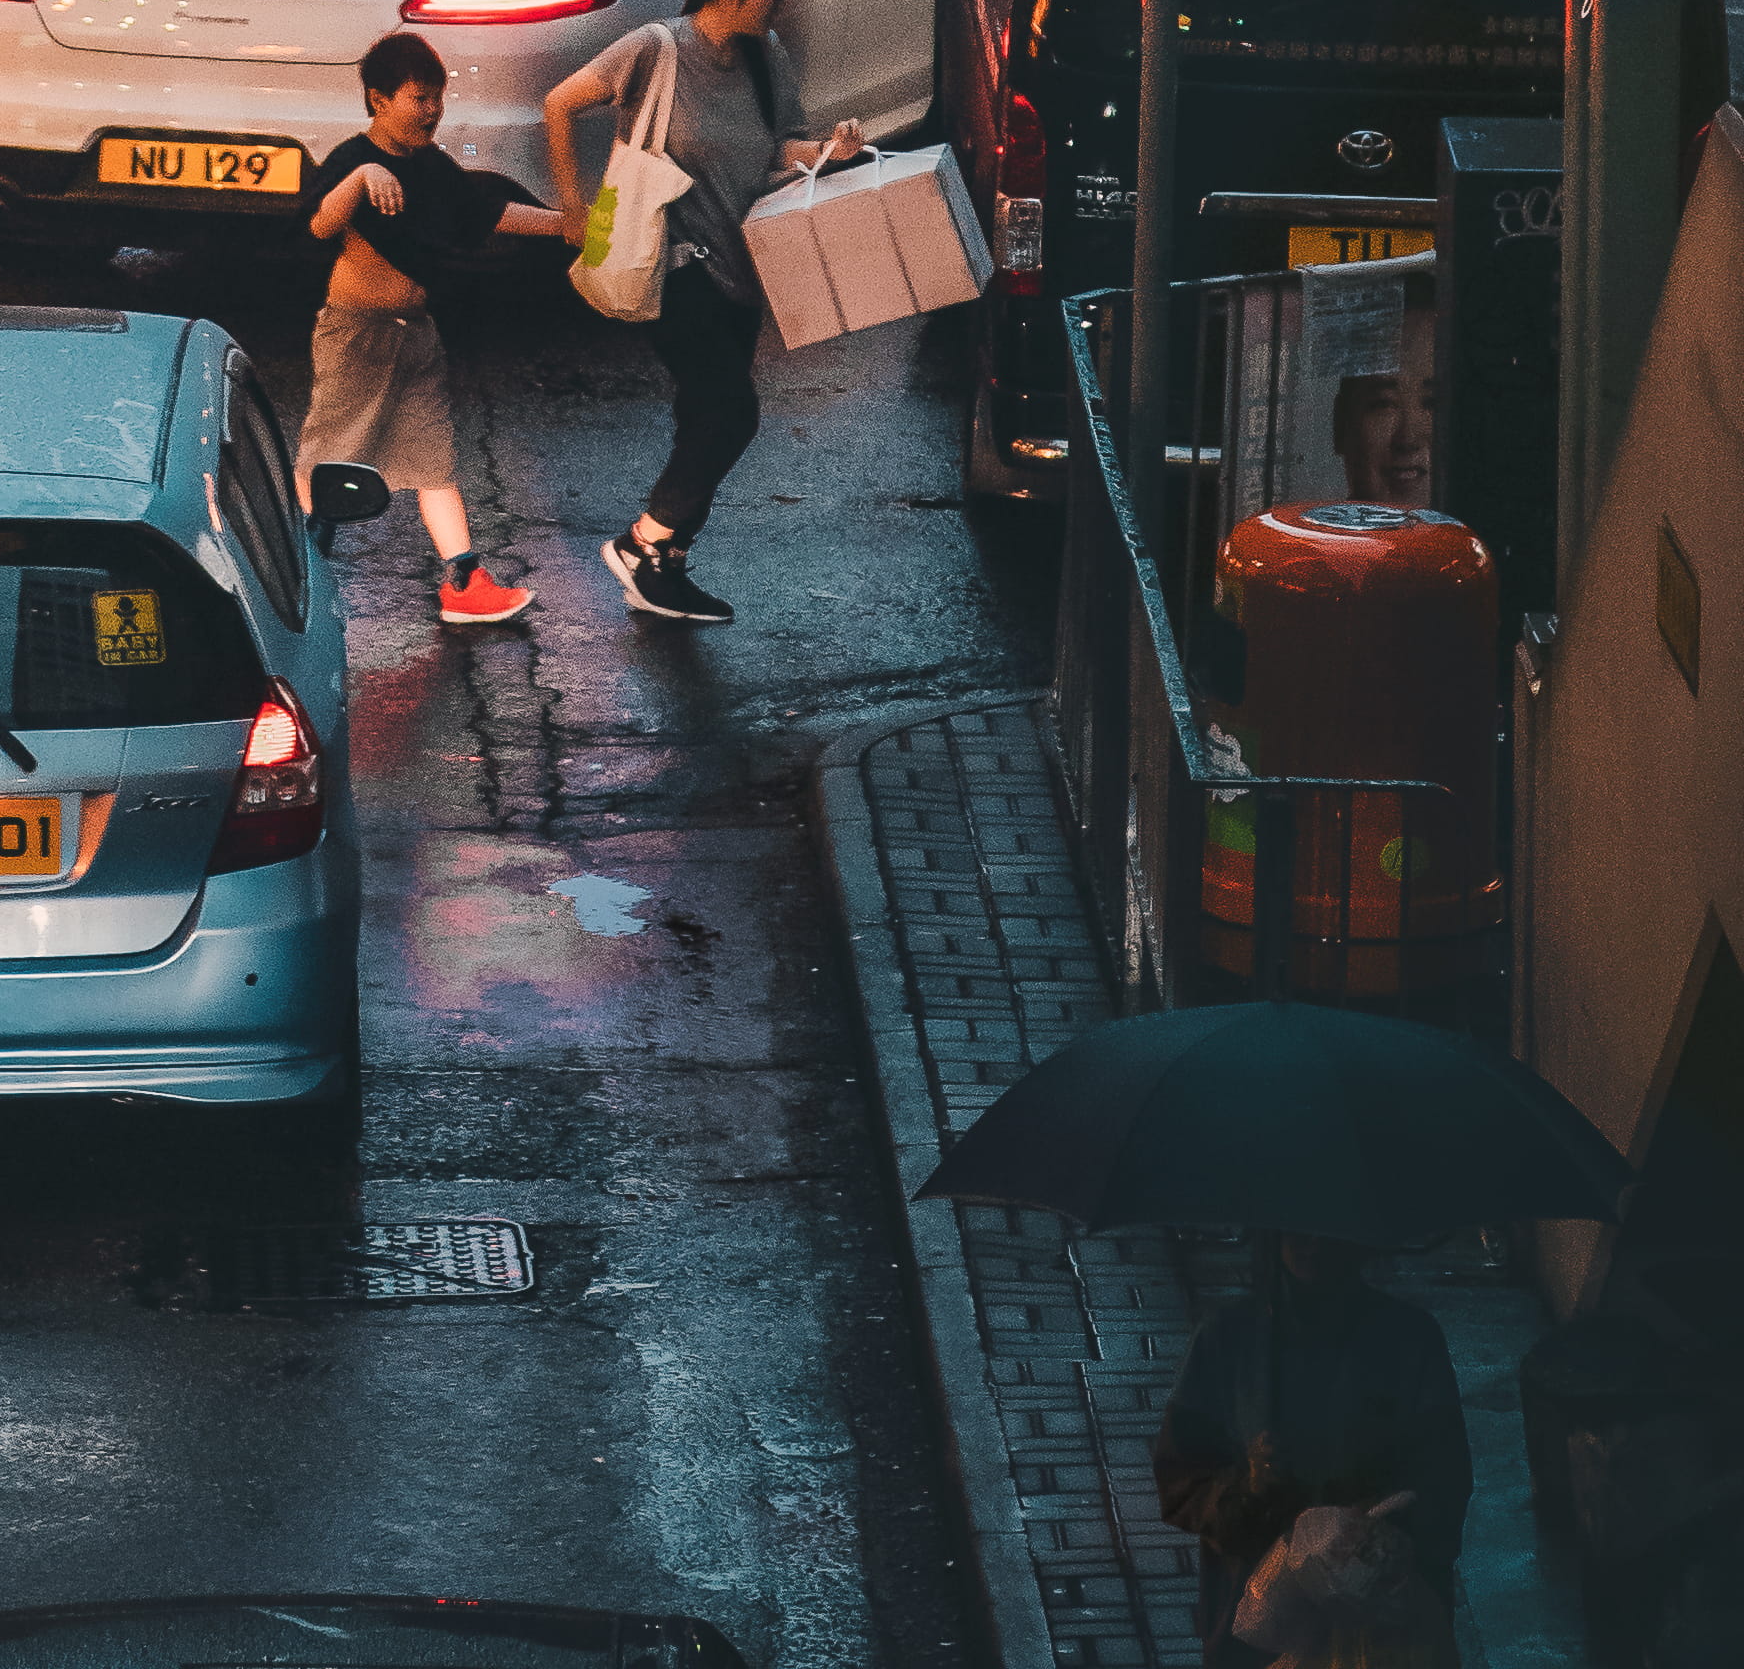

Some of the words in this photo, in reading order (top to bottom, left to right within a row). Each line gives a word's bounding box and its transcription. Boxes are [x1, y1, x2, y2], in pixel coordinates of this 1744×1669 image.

[131, 145, 185, 181] NU
[205, 147, 272, 185] 129
[99, 635, 159, 651] BABY
